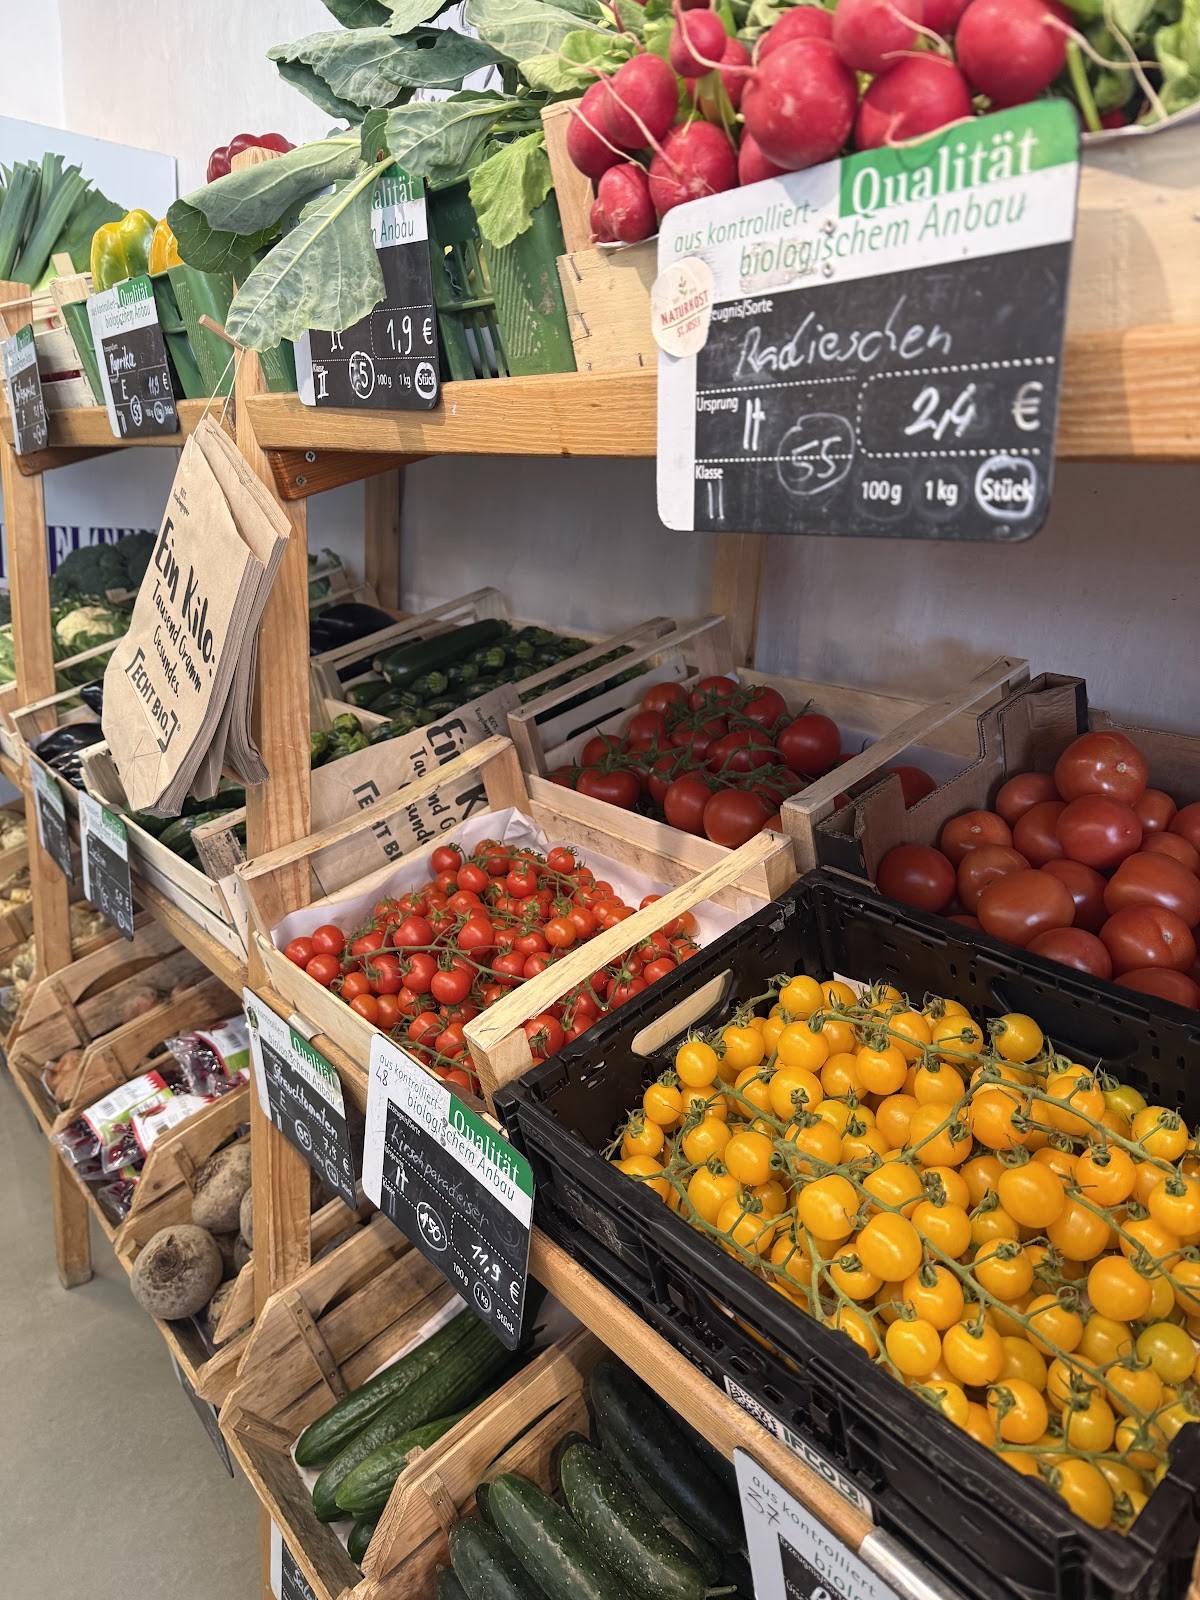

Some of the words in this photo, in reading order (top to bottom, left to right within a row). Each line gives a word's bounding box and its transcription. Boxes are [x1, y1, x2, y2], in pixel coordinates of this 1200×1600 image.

[852, 128, 1039, 219] Qualität
[380, 217, 414, 243] Anbau
[674, 230, 702, 254] aus
[707, 201, 820, 246] kontrolliert-
[739, 218, 910, 277] biologischem
[917, 191, 1027, 242] Anbau
[120, 282, 149, 309] Qualität
[660, 289, 710, 326] NATURKOST
[386, 315, 412, 355] 1,9
[422, 317, 433, 345] €
[732, 293, 952, 381] Radieschen
[109, 345, 137, 378] Paprika
[418, 372, 436, 386] Stück
[121, 378, 129, 400] E
[162, 372, 170, 390] €
[696, 396, 739, 415] Ursprung
[903, 382, 977, 441] 2,4
[1011, 380, 1044, 432] €
[694, 464, 724, 480] Klasse
[789, 435, 843, 482] 55
[982, 477, 1034, 502] Stück
[154, 516, 180, 604] Ein
[152, 578, 180, 645] Tausend
[179, 634, 202, 694] Gramm
[153, 623, 180, 698] Gesundes.
[293, 1036, 335, 1087] Qualität
[379, 1053, 393, 1072] aus
[312, 1071, 335, 1105] Anbau
[342, 1157, 350, 1176] €
[407, 1092, 476, 1164] biologischem
[477, 1155, 516, 1202] Anbau
[453, 1109, 520, 1186] Qualität
[470, 1244, 502, 1282] 11,9
[509, 1280, 521, 1305] €
[495, 1308, 515, 1335] Stück
[782, 1426, 837, 1482] IFCO
[752, 1475, 778, 1504] aus
